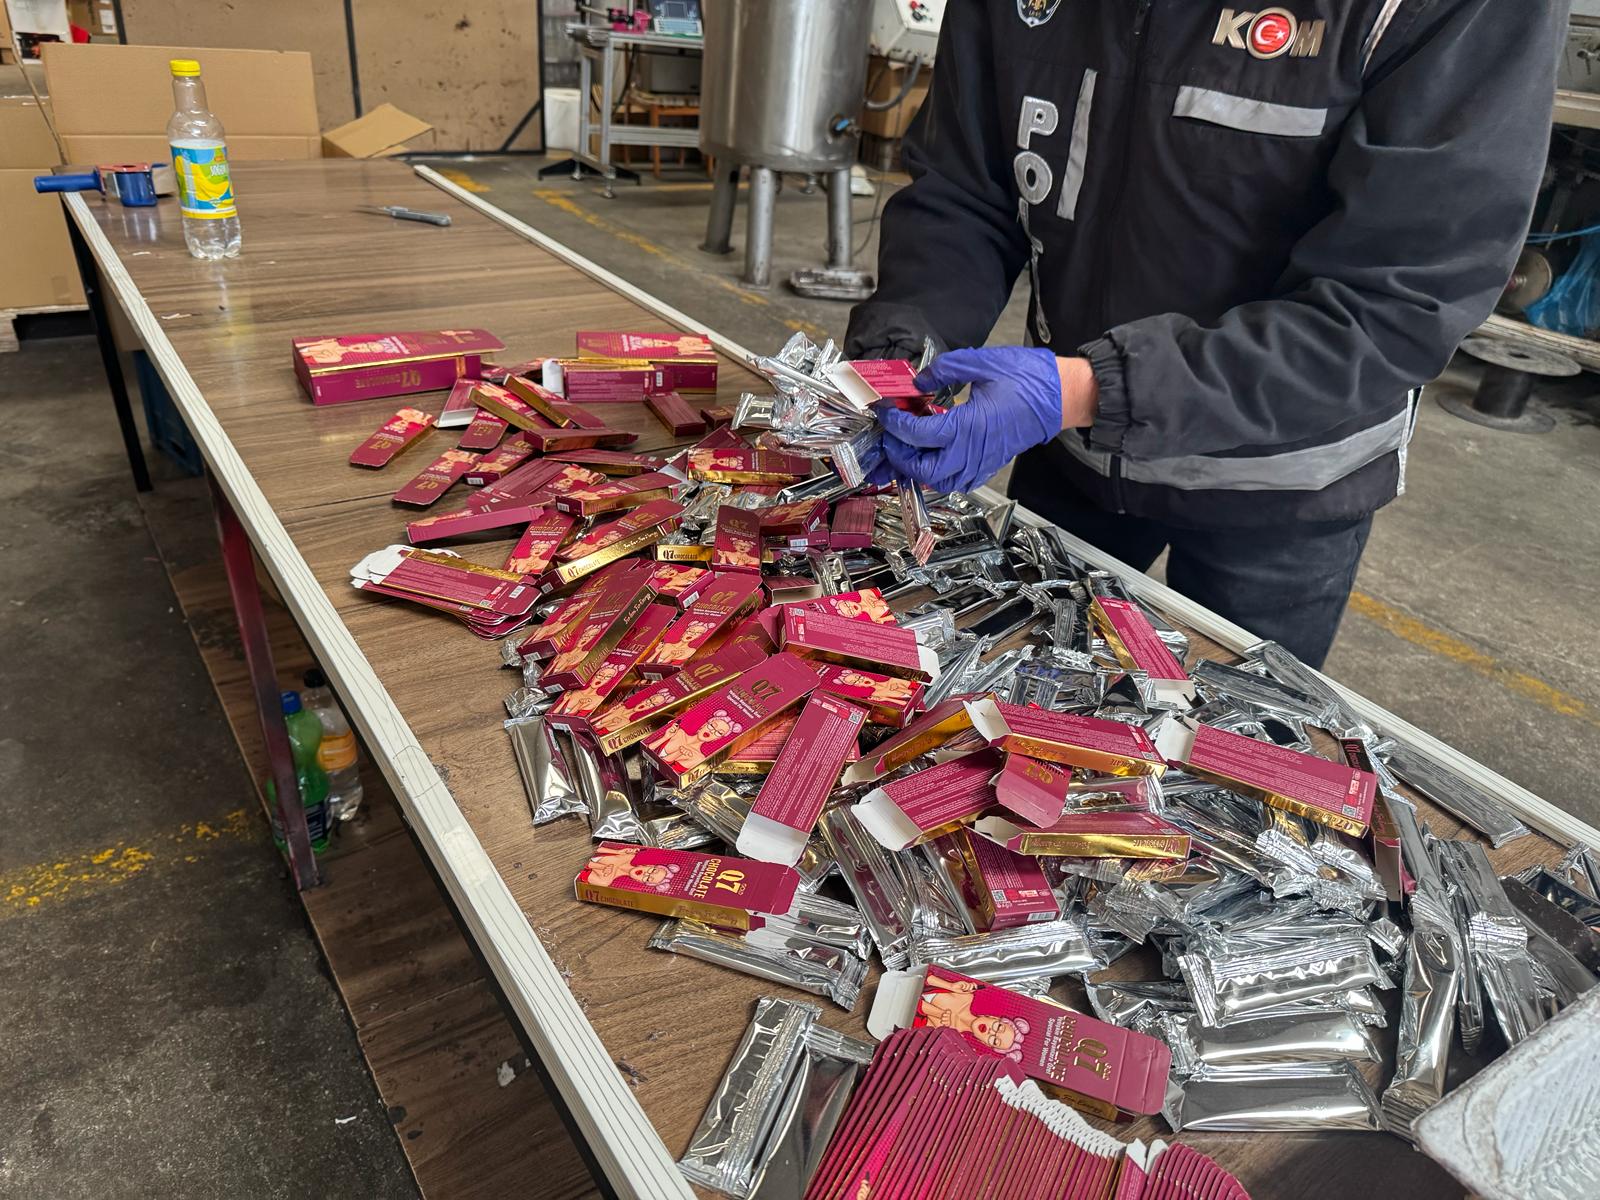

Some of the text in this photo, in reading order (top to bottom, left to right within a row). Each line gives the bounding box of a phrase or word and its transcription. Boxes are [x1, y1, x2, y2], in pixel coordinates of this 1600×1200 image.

[1212, 7, 1326, 59] KOM
[663, 550, 674, 559] Q7
[711, 591, 738, 603] Q7
[694, 602, 734, 613] CHOCOLATE
[751, 679, 783, 701] Q7
[608, 724, 652, 749] Q7 CHOCOLATE
[688, 768, 700, 783] Q7
[1023, 763, 1053, 784] Q7
[1335, 819, 1353, 831] Q7
[693, 859, 721, 899] CHOCOLATE
[715, 870, 744, 893] Q7
[585, 889, 635, 908] Q7 CHOCOLATE
[1046, 1018, 1055, 1037] Special
[1039, 1047, 1048, 1067] Women
[1050, 1015, 1077, 1082] CHOCOLATE
[1073, 1037, 1107, 1078] Q7
